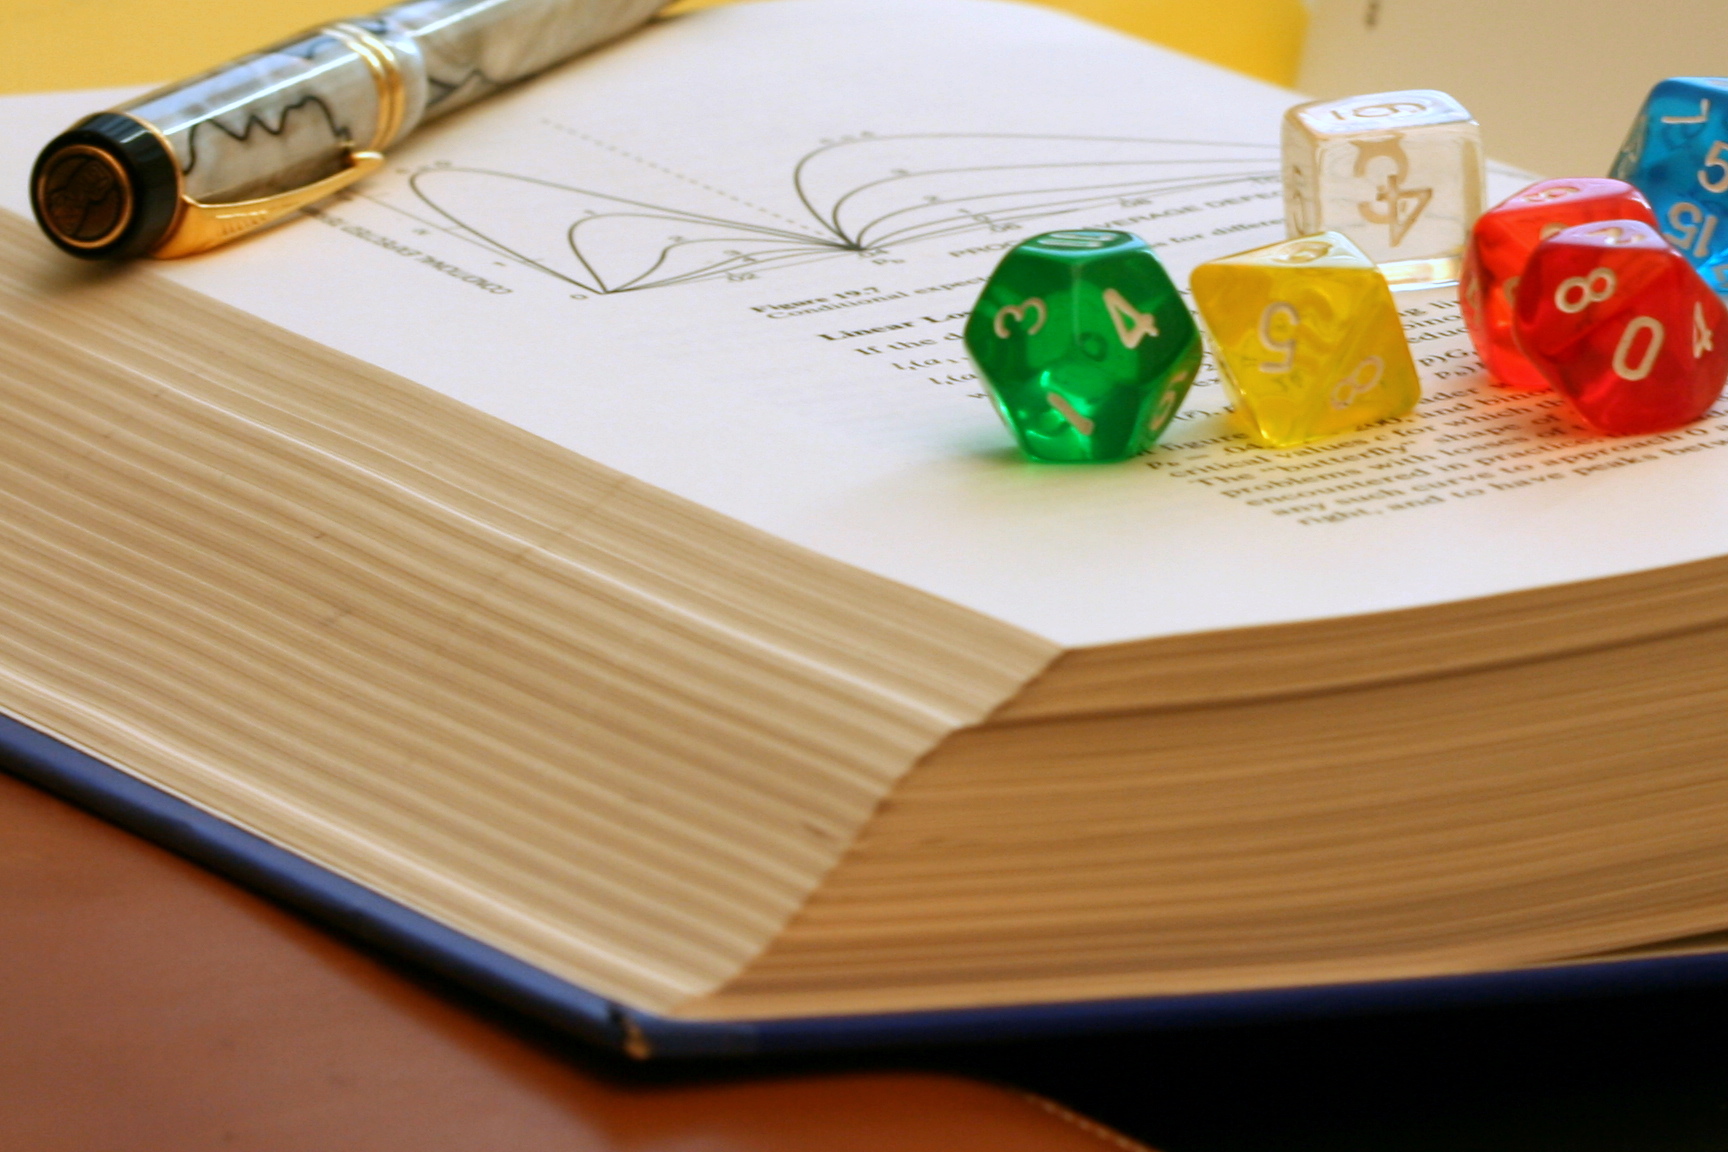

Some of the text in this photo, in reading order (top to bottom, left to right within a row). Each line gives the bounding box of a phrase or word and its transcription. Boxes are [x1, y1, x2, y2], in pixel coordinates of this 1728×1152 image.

[750, 294, 828, 313] Figure
[765, 291, 909, 321] Conditional
[993, 297, 1047, 339] 3
[1102, 287, 1160, 348] 4
[1554, 267, 1616, 313] 8
[817, 320, 914, 342] Linear
[1612, 316, 1664, 380] 0
[1692, 301, 1713, 359] 4
[1169, 406, 1531, 479] critical values for which
[1187, 472, 1254, 489] The
[1432, 422, 1523, 447] shape
[1219, 434, 1529, 500] problems with losses
[1245, 467, 1432, 507] encountered
[1270, 499, 1329, 517] any
[1334, 486, 1406, 507] such
[1410, 468, 1497, 493] curve
[1541, 432, 1684, 468] approach
[1296, 508, 1383, 528] right,
[1451, 486, 1485, 500] to
[1488, 471, 1566, 492] have
[1571, 452, 1660, 478] peaks
